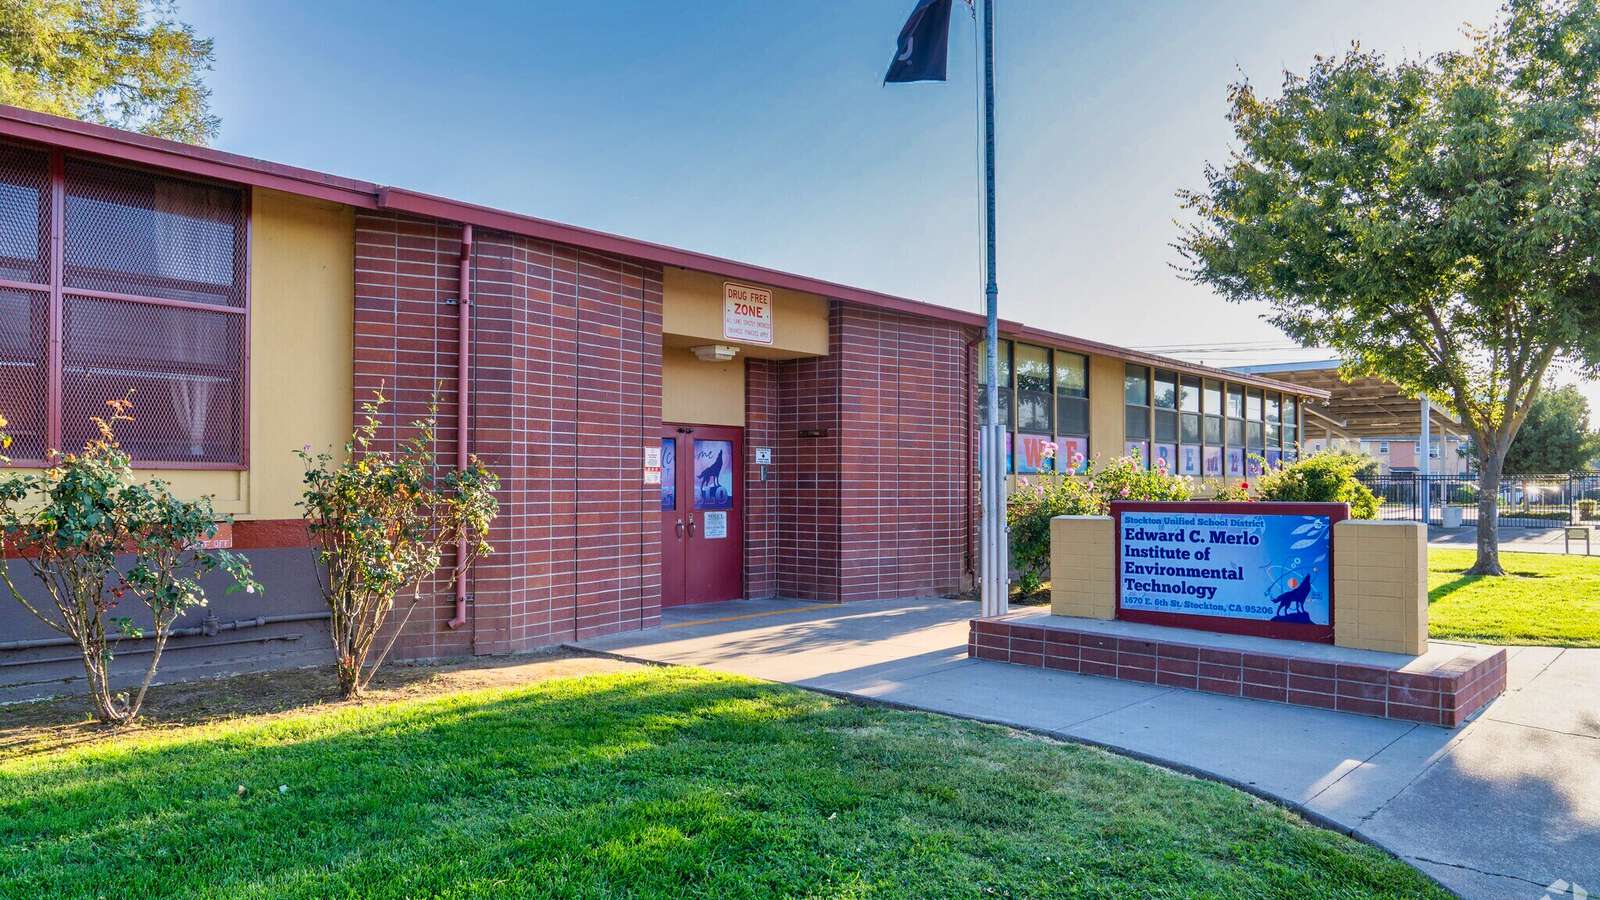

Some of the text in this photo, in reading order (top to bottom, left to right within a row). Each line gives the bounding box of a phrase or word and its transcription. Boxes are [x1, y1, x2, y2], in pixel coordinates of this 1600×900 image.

[728, 289, 768, 304] DRUG FREE
[734, 303, 763, 318] ZONE
[1125, 516, 1265, 528] Stockton Unified School District
[1125, 528, 1259, 545] Edward C. Merlo
[1125, 545, 1211, 560] Institute of
[1125, 562, 1244, 580] Environmental
[1124, 578, 1217, 599] Technology
[1184, 601, 1227, 612] Stockton,
[1229, 604, 1242, 612] CA
[1245, 606, 1274, 614] 95206
